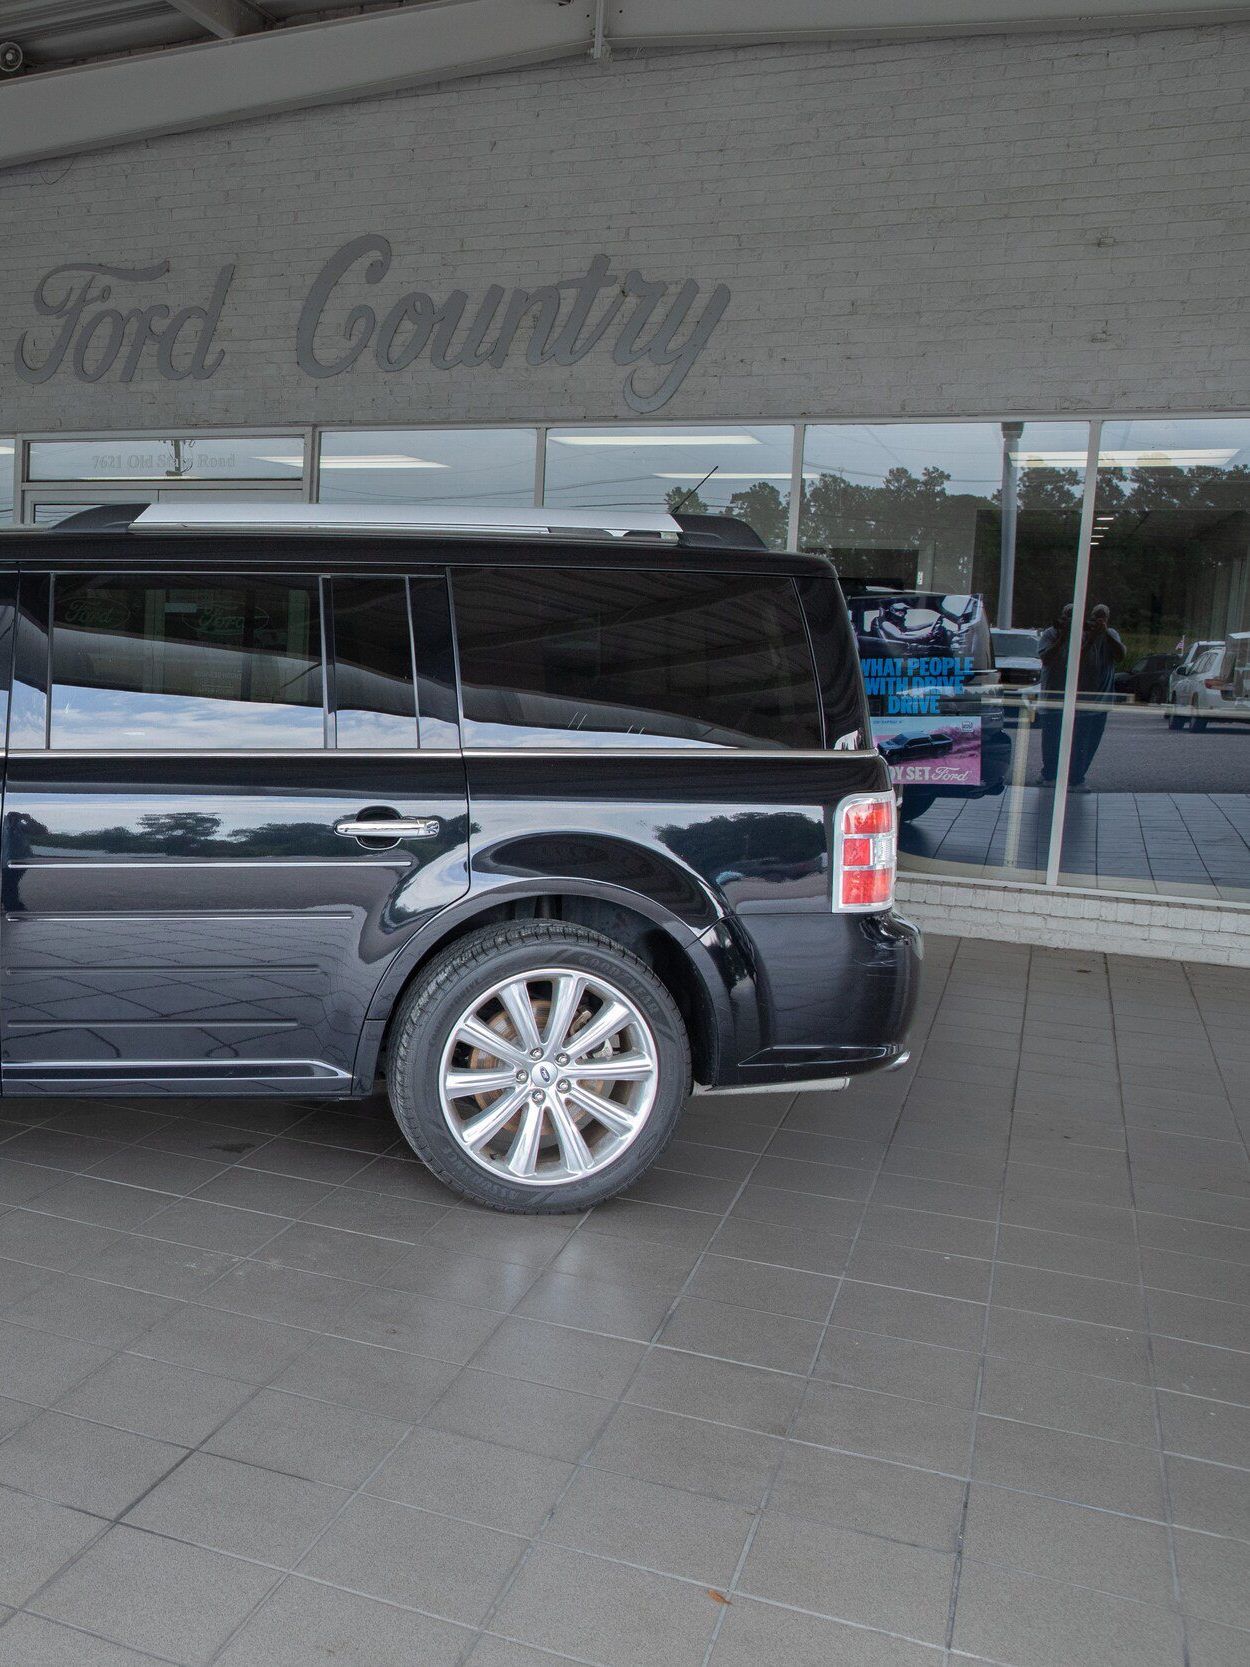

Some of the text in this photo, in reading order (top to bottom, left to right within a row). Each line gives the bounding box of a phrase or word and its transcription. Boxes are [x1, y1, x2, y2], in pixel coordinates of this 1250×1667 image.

[14, 261, 235, 385] Ford
[297, 234, 730, 413] Country
[92, 454, 122, 469] 7621
[127, 454, 153, 469] Old
[197, 453, 236, 468] Road
[907, 657, 975, 676] PEOPLE
[865, 676, 965, 695] WITH DRIVE
[887, 695, 941, 714] DRIVE
[906, 766, 932, 781] SET
[931, 766, 969, 782] Ford
